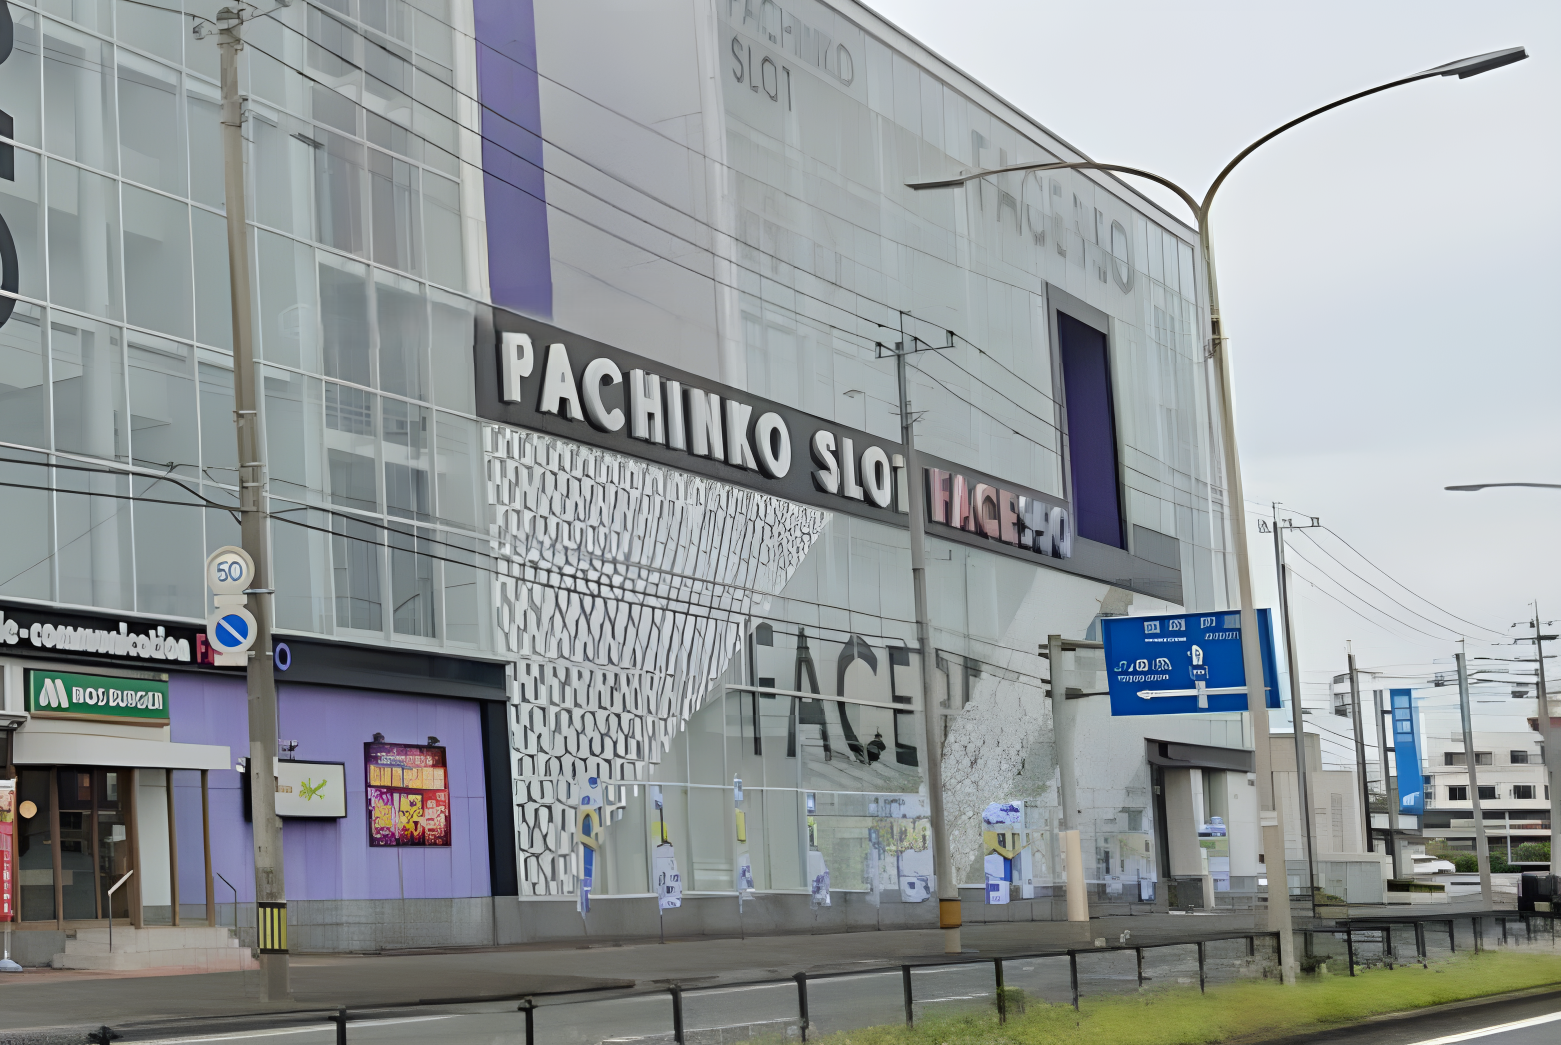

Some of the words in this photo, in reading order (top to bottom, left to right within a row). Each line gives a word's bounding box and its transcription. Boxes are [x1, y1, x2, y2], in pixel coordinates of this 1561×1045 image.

[731, 33, 793, 113] SLOT
[501, 331, 792, 479] PACHINKO
[216, 560, 243, 583] 50
